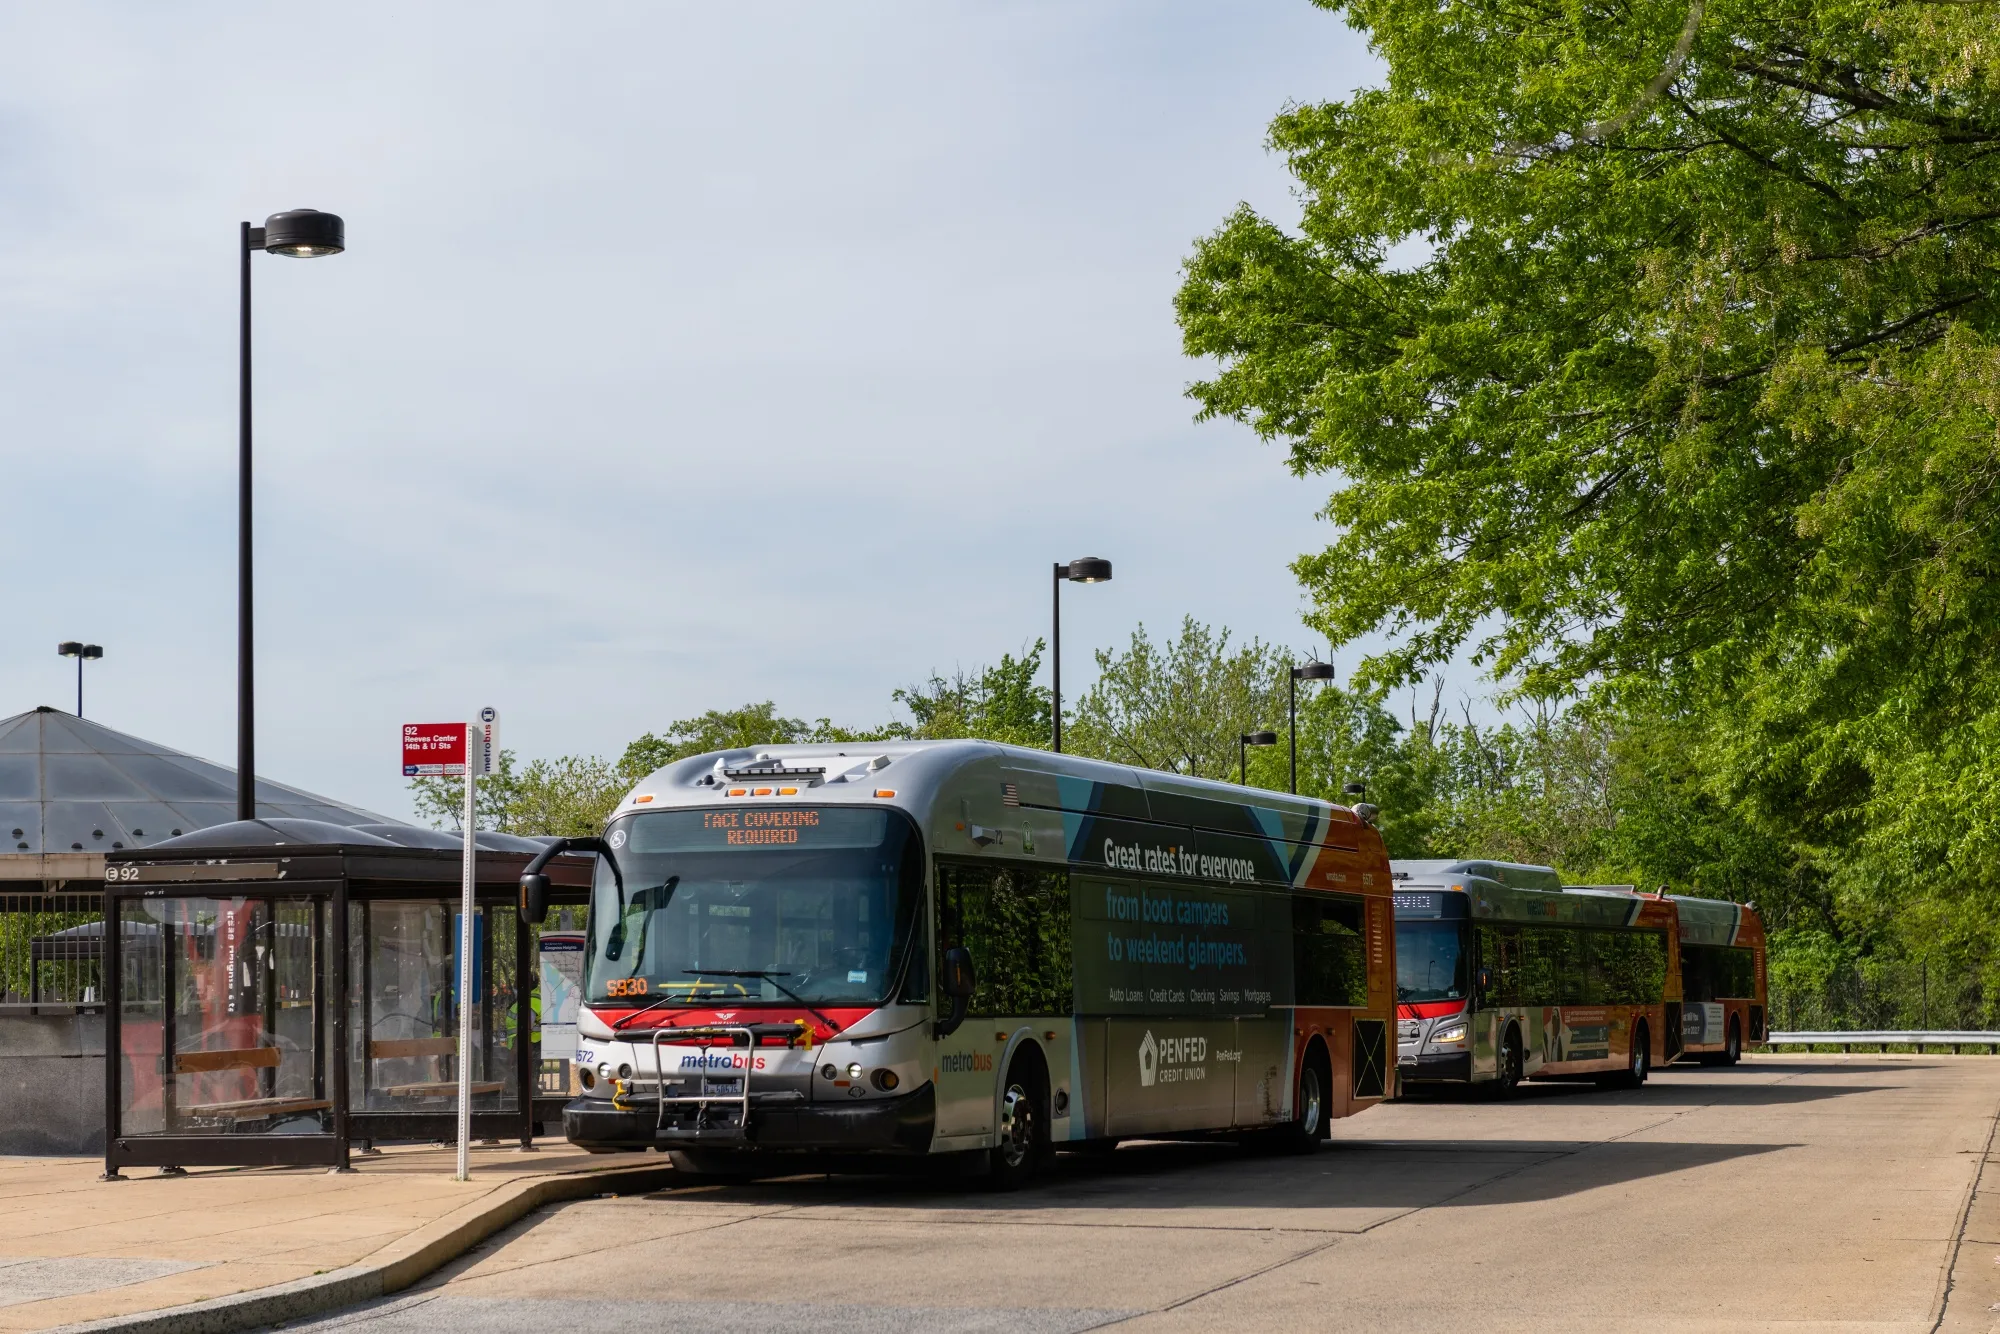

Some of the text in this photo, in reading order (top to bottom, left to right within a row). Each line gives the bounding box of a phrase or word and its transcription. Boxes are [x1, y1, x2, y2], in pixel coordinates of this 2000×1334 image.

[404, 726, 418, 736] 92
[430, 742, 437, 750] U
[438, 742, 451, 750] Sts
[483, 724, 492, 772] metrobus
[704, 811, 819, 828] FACE COVERING
[727, 829, 798, 845] REQUIRED
[1104, 837, 1255, 883] Great rates for everyone
[120, 867, 139, 880] 92
[1106, 886, 1229, 930] from boot campers
[1107, 932, 1247, 970] to weekend glampers.
[1109, 988, 1271, 1004] Auto Loans Credit Cards Checking Savings Mortgages
[1160, 1037, 1206, 1064] PENFED
[681, 1053, 765, 1069] metrobus
[942, 1050, 993, 1072] metrobus
[1159, 1067, 1206, 1082] CREDIT UNION
